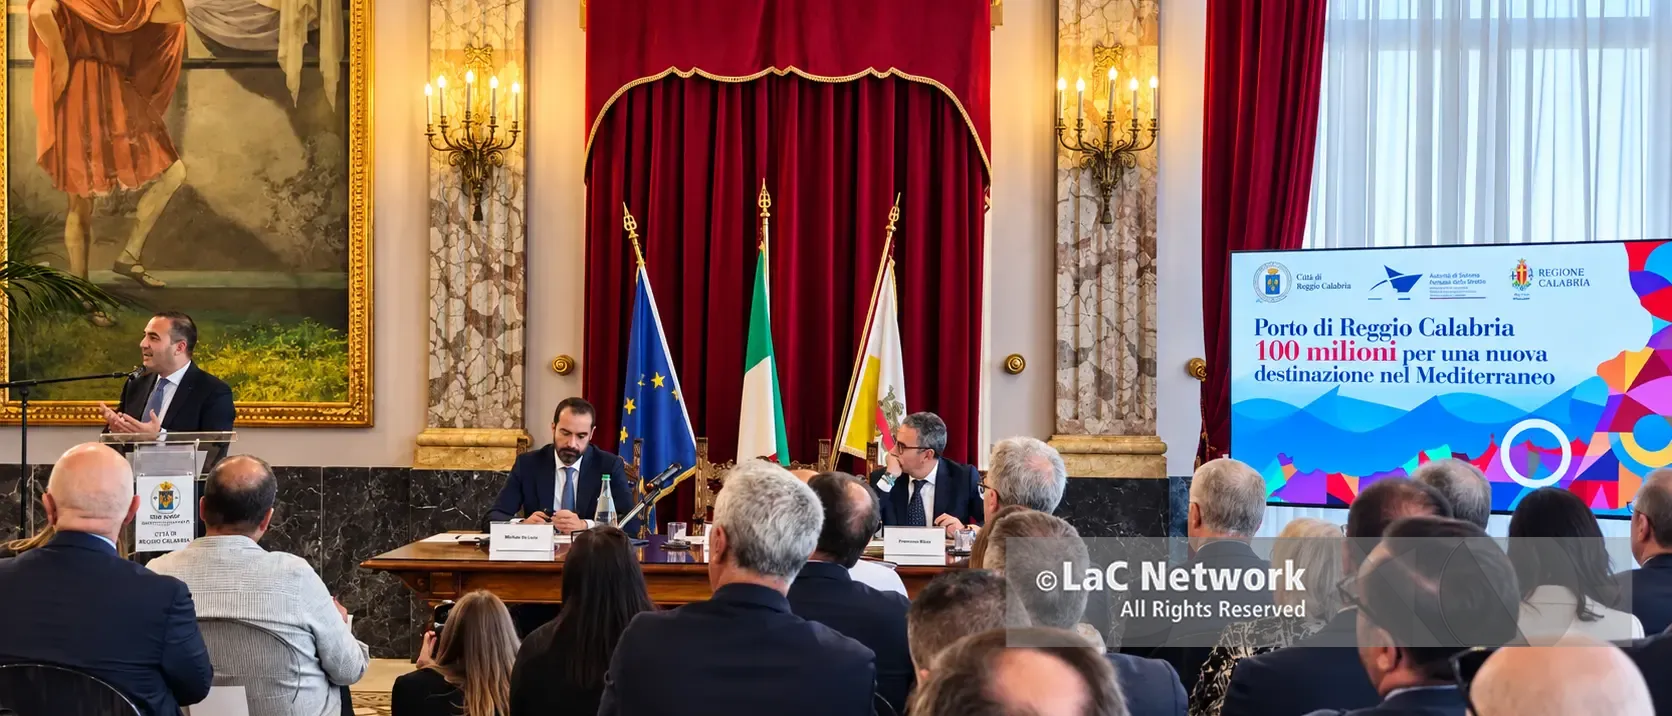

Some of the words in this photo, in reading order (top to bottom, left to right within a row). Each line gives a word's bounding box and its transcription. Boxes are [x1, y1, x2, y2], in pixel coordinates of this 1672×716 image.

[1538, 267, 1585, 277] REGIONE
[1296, 282, 1320, 292] Reggio
[1321, 282, 1352, 290] Calabria
[1538, 278, 1591, 288] CALABRIA
[1254, 317, 1308, 336] Porto
[1313, 317, 1333, 336] di
[1340, 317, 1413, 343] Reggio
[1418, 316, 1515, 337] Calabria
[1255, 339, 1300, 361] 100
[1306, 339, 1397, 361] milioni
[1402, 348, 1436, 366] per
[1441, 349, 1480, 362] una
[1485, 349, 1548, 362] nuova
[1254, 364, 1374, 383] destinazione
[1380, 365, 1410, 384] nel
[1416, 366, 1556, 386] Mediterraneo
